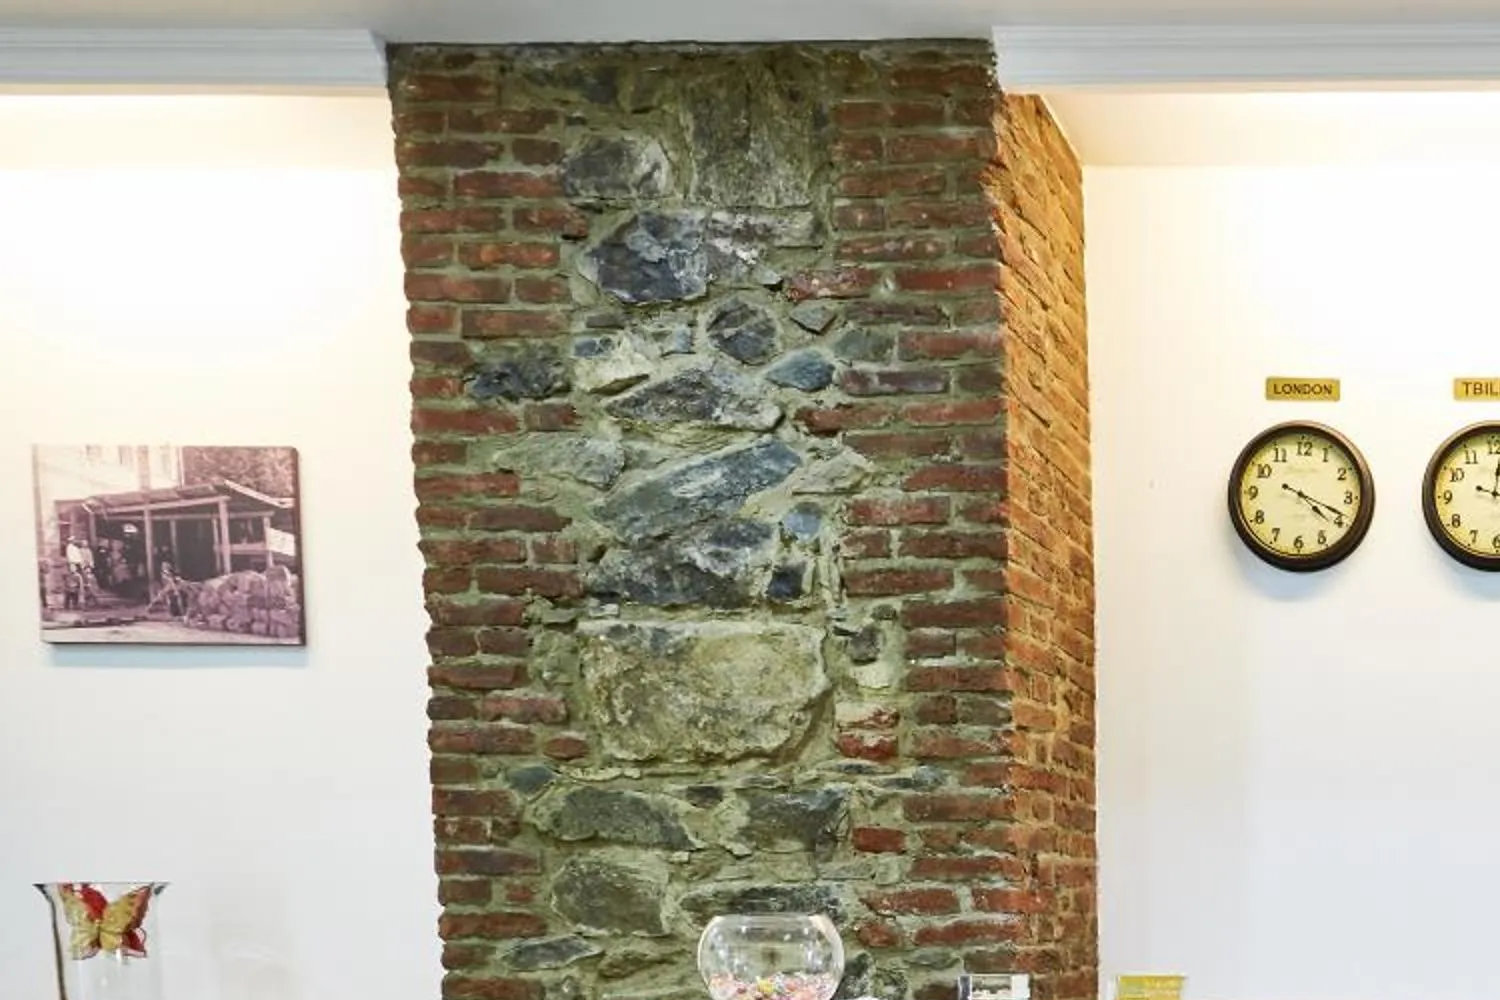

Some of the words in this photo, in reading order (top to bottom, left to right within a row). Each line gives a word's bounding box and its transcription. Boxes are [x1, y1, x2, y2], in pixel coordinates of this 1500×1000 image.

[1273, 383, 1333, 396] LONDON
[1272, 447, 1287, 463] 11
[1296, 441, 1313, 456] 12
[1322, 447, 1329, 462] 1
[1464, 451, 1478, 465] 11
[1256, 464, 1272, 478] 10
[1337, 468, 1347, 481] 2
[1449, 468, 1465, 482] 10
[1248, 486, 1259, 500] 9
[1344, 492, 1353, 504] 3
[1443, 491, 1452, 504] 9
[1254, 511, 1265, 524] 8
[1333, 515, 1344, 528] 4
[1452, 514, 1461, 528] 8
[1271, 528, 1280, 542] 7
[1293, 535, 1304, 549] 6
[1317, 530, 1327, 544] 5
[1470, 529, 1478, 543] 7
